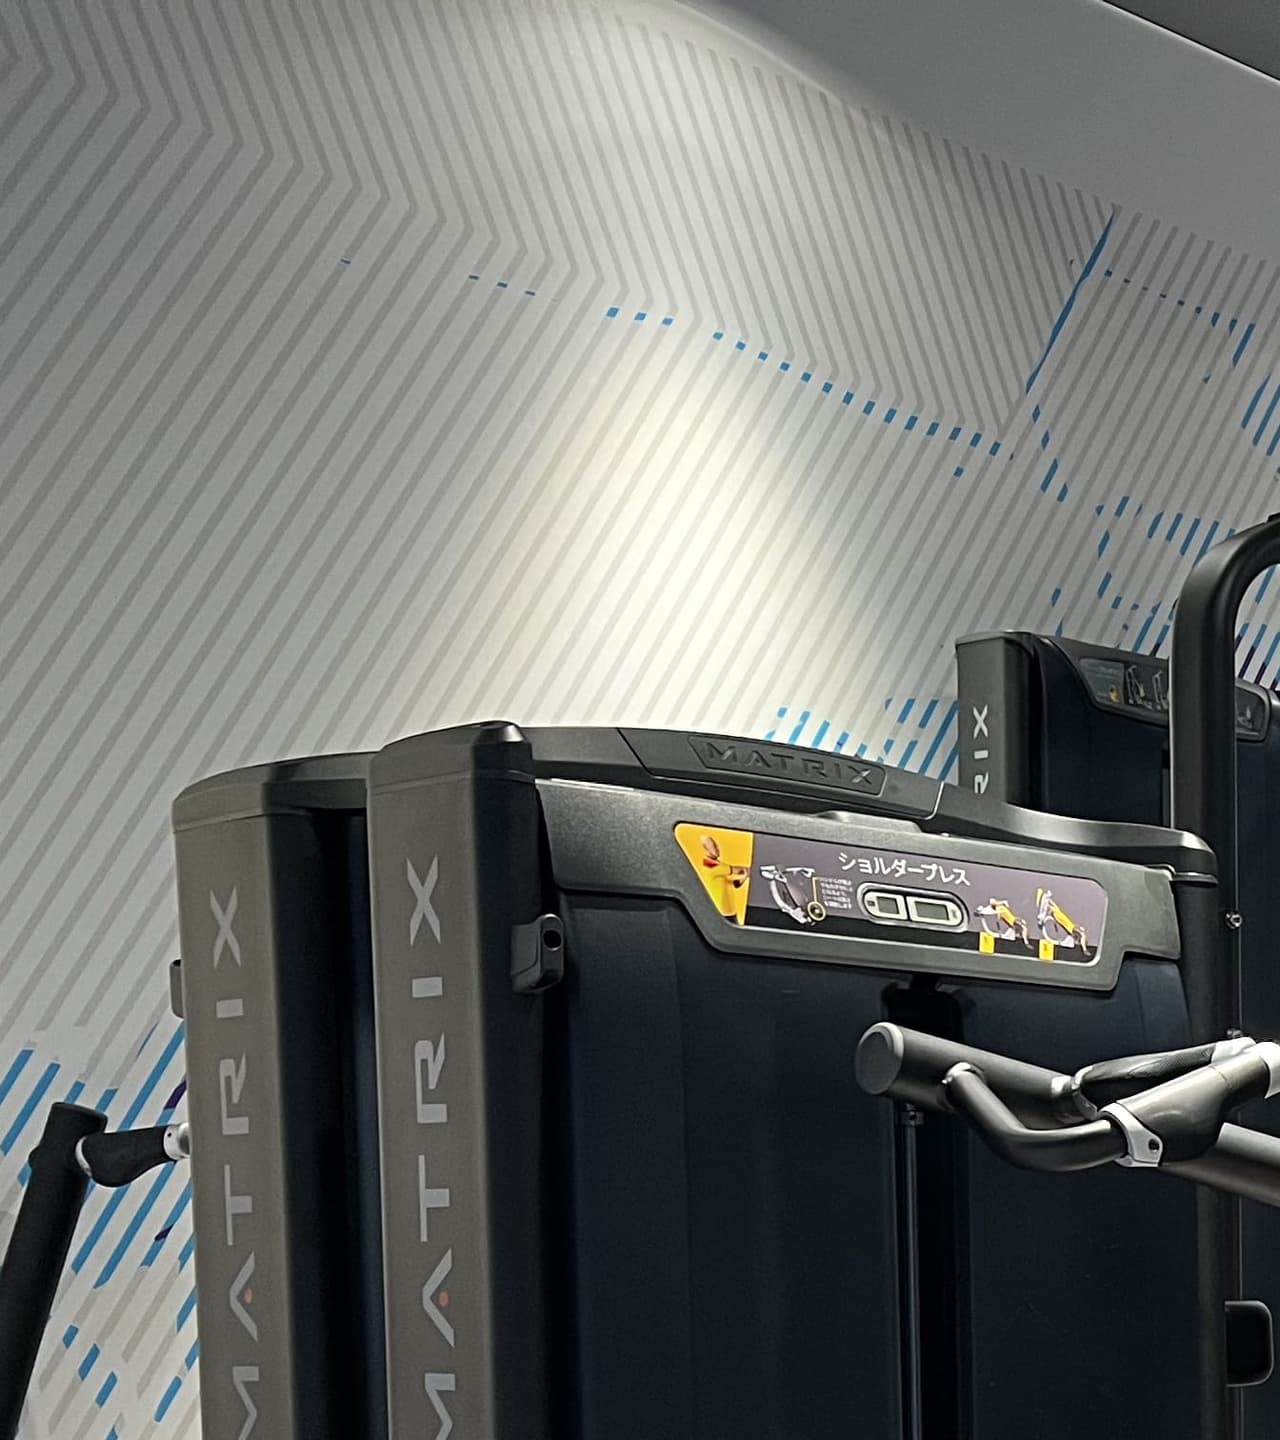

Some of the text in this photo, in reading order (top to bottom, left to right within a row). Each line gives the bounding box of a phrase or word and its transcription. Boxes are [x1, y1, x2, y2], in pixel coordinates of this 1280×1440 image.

[706, 741, 873, 786] MATRIX
[837, 851, 971, 887] ショルダープレス
